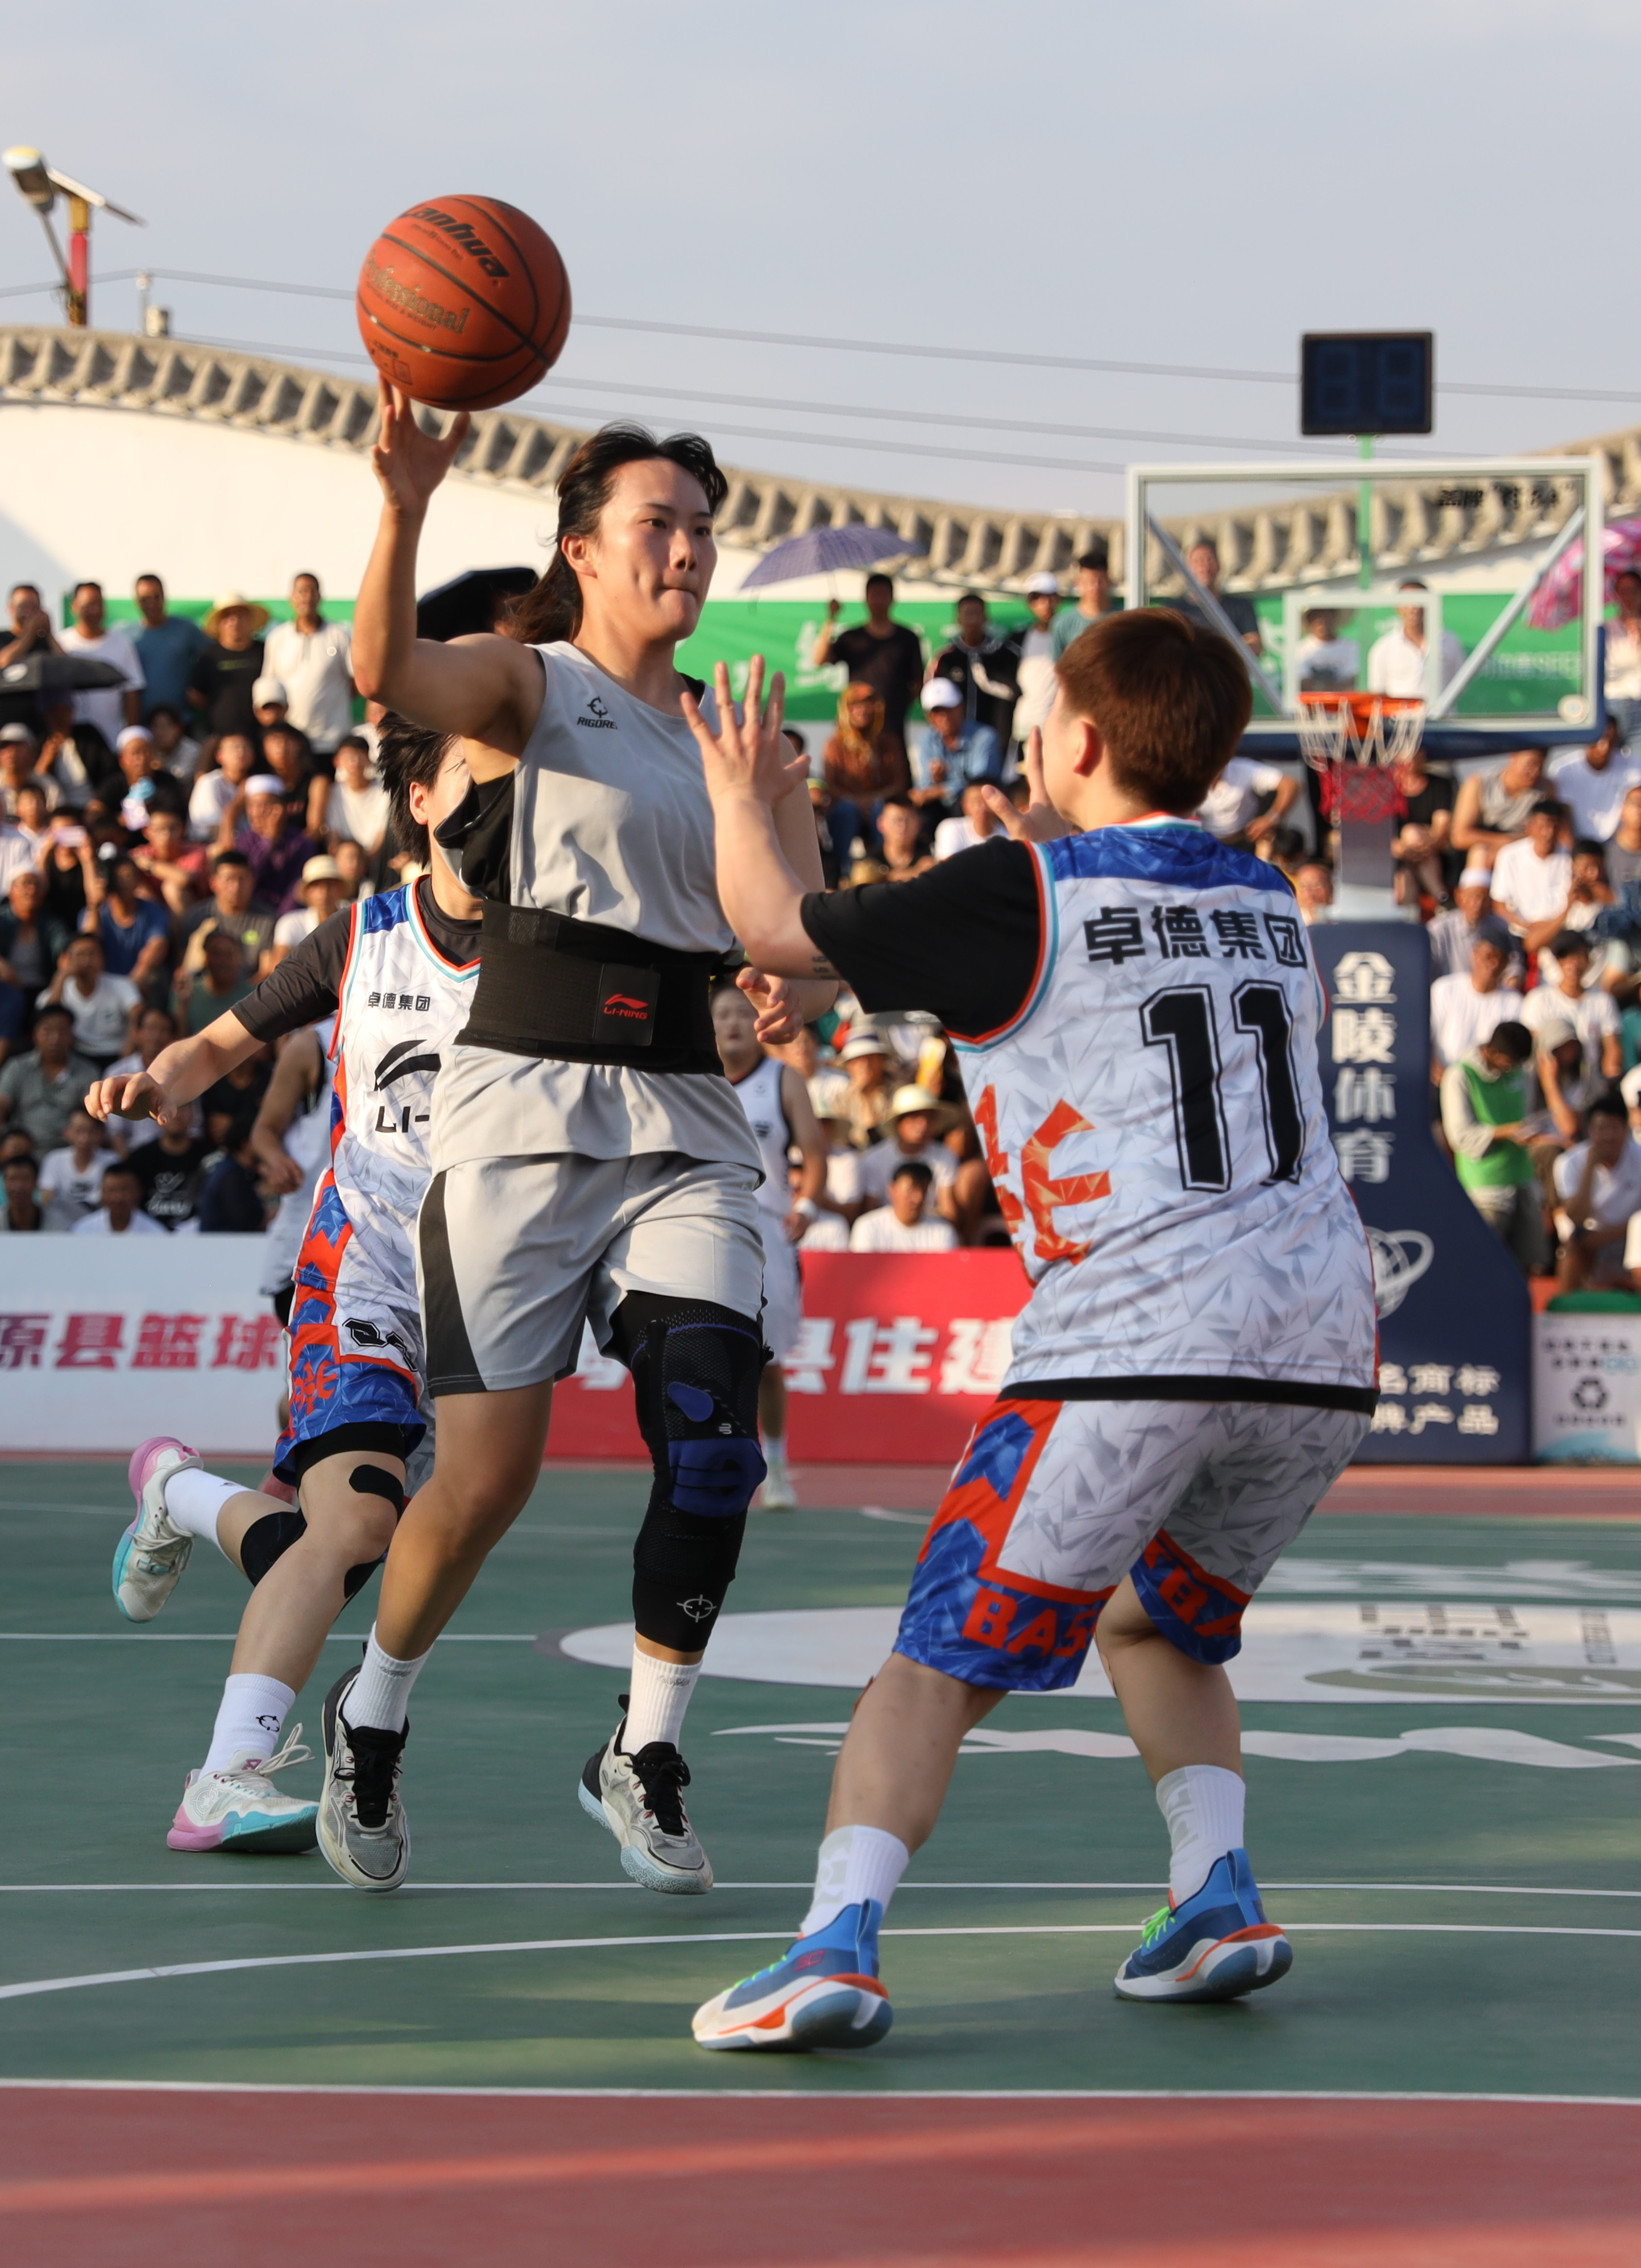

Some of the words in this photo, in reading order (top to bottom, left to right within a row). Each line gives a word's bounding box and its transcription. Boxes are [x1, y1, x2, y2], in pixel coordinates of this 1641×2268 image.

[577, 716, 619, 731] RIGORE
[1084, 905, 1307, 968] 卓德集团
[368, 992, 430, 1011] 卓德集团
[603, 1006, 648, 1019] LI-NING
[1138, 978, 1306, 1194] 11
[1331, 951, 1398, 1185] 金陵体育
[961, 1586, 1097, 1658] BAS
